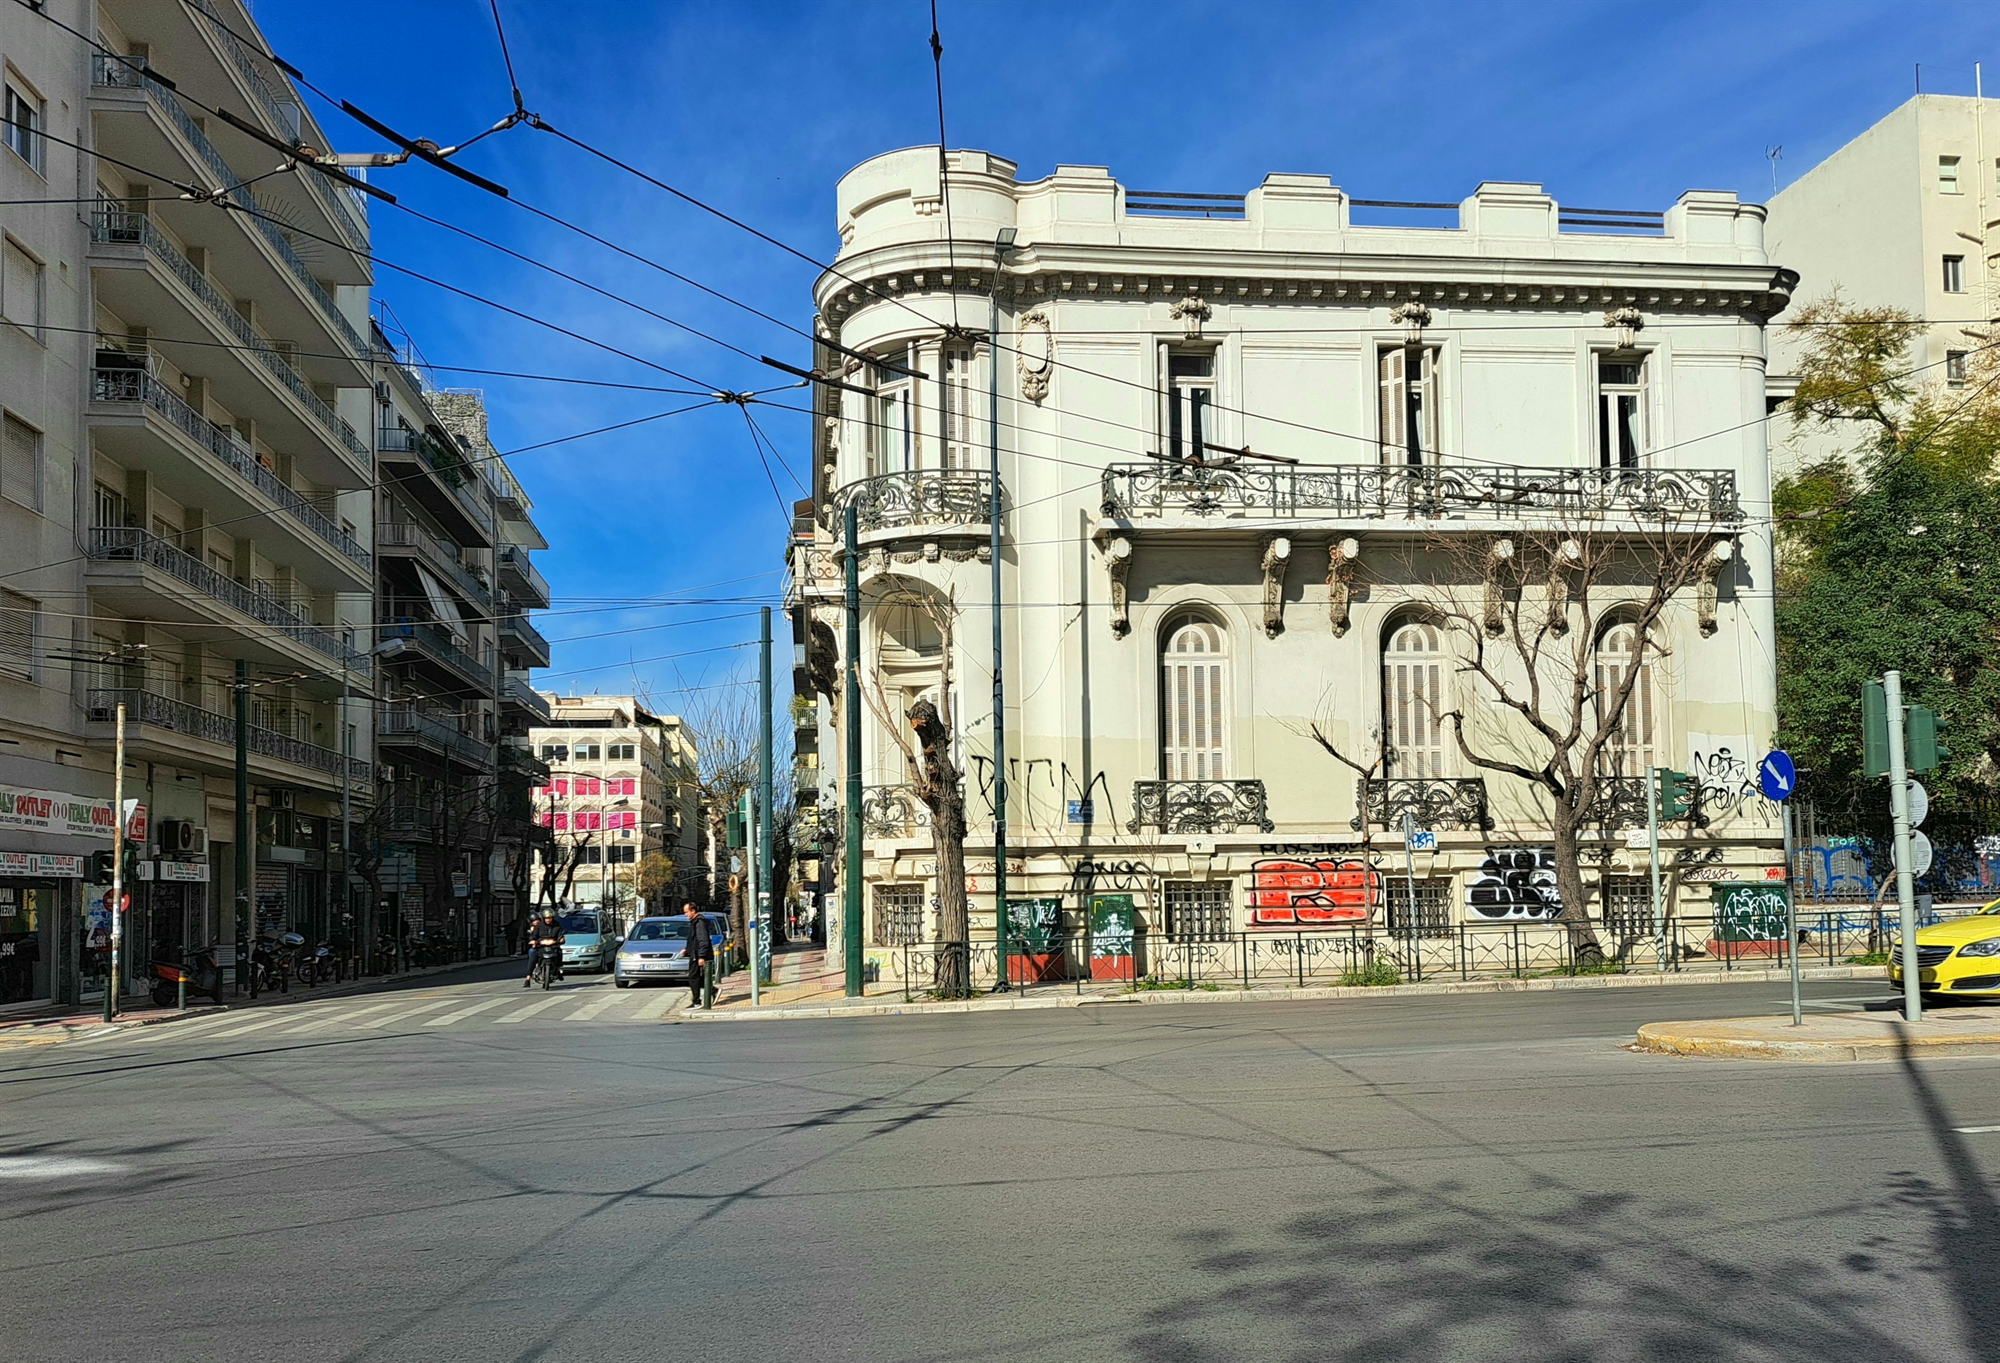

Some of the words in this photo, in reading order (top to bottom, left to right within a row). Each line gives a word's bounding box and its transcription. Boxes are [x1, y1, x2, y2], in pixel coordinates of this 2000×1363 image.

[16, 795, 52, 818] OUTLET
[68, 802, 92, 824] ITALY
[6, 853, 28, 865] OUTLET
[40, 855, 55, 865] ITALY
[55, 856, 74, 867] OUTLET
